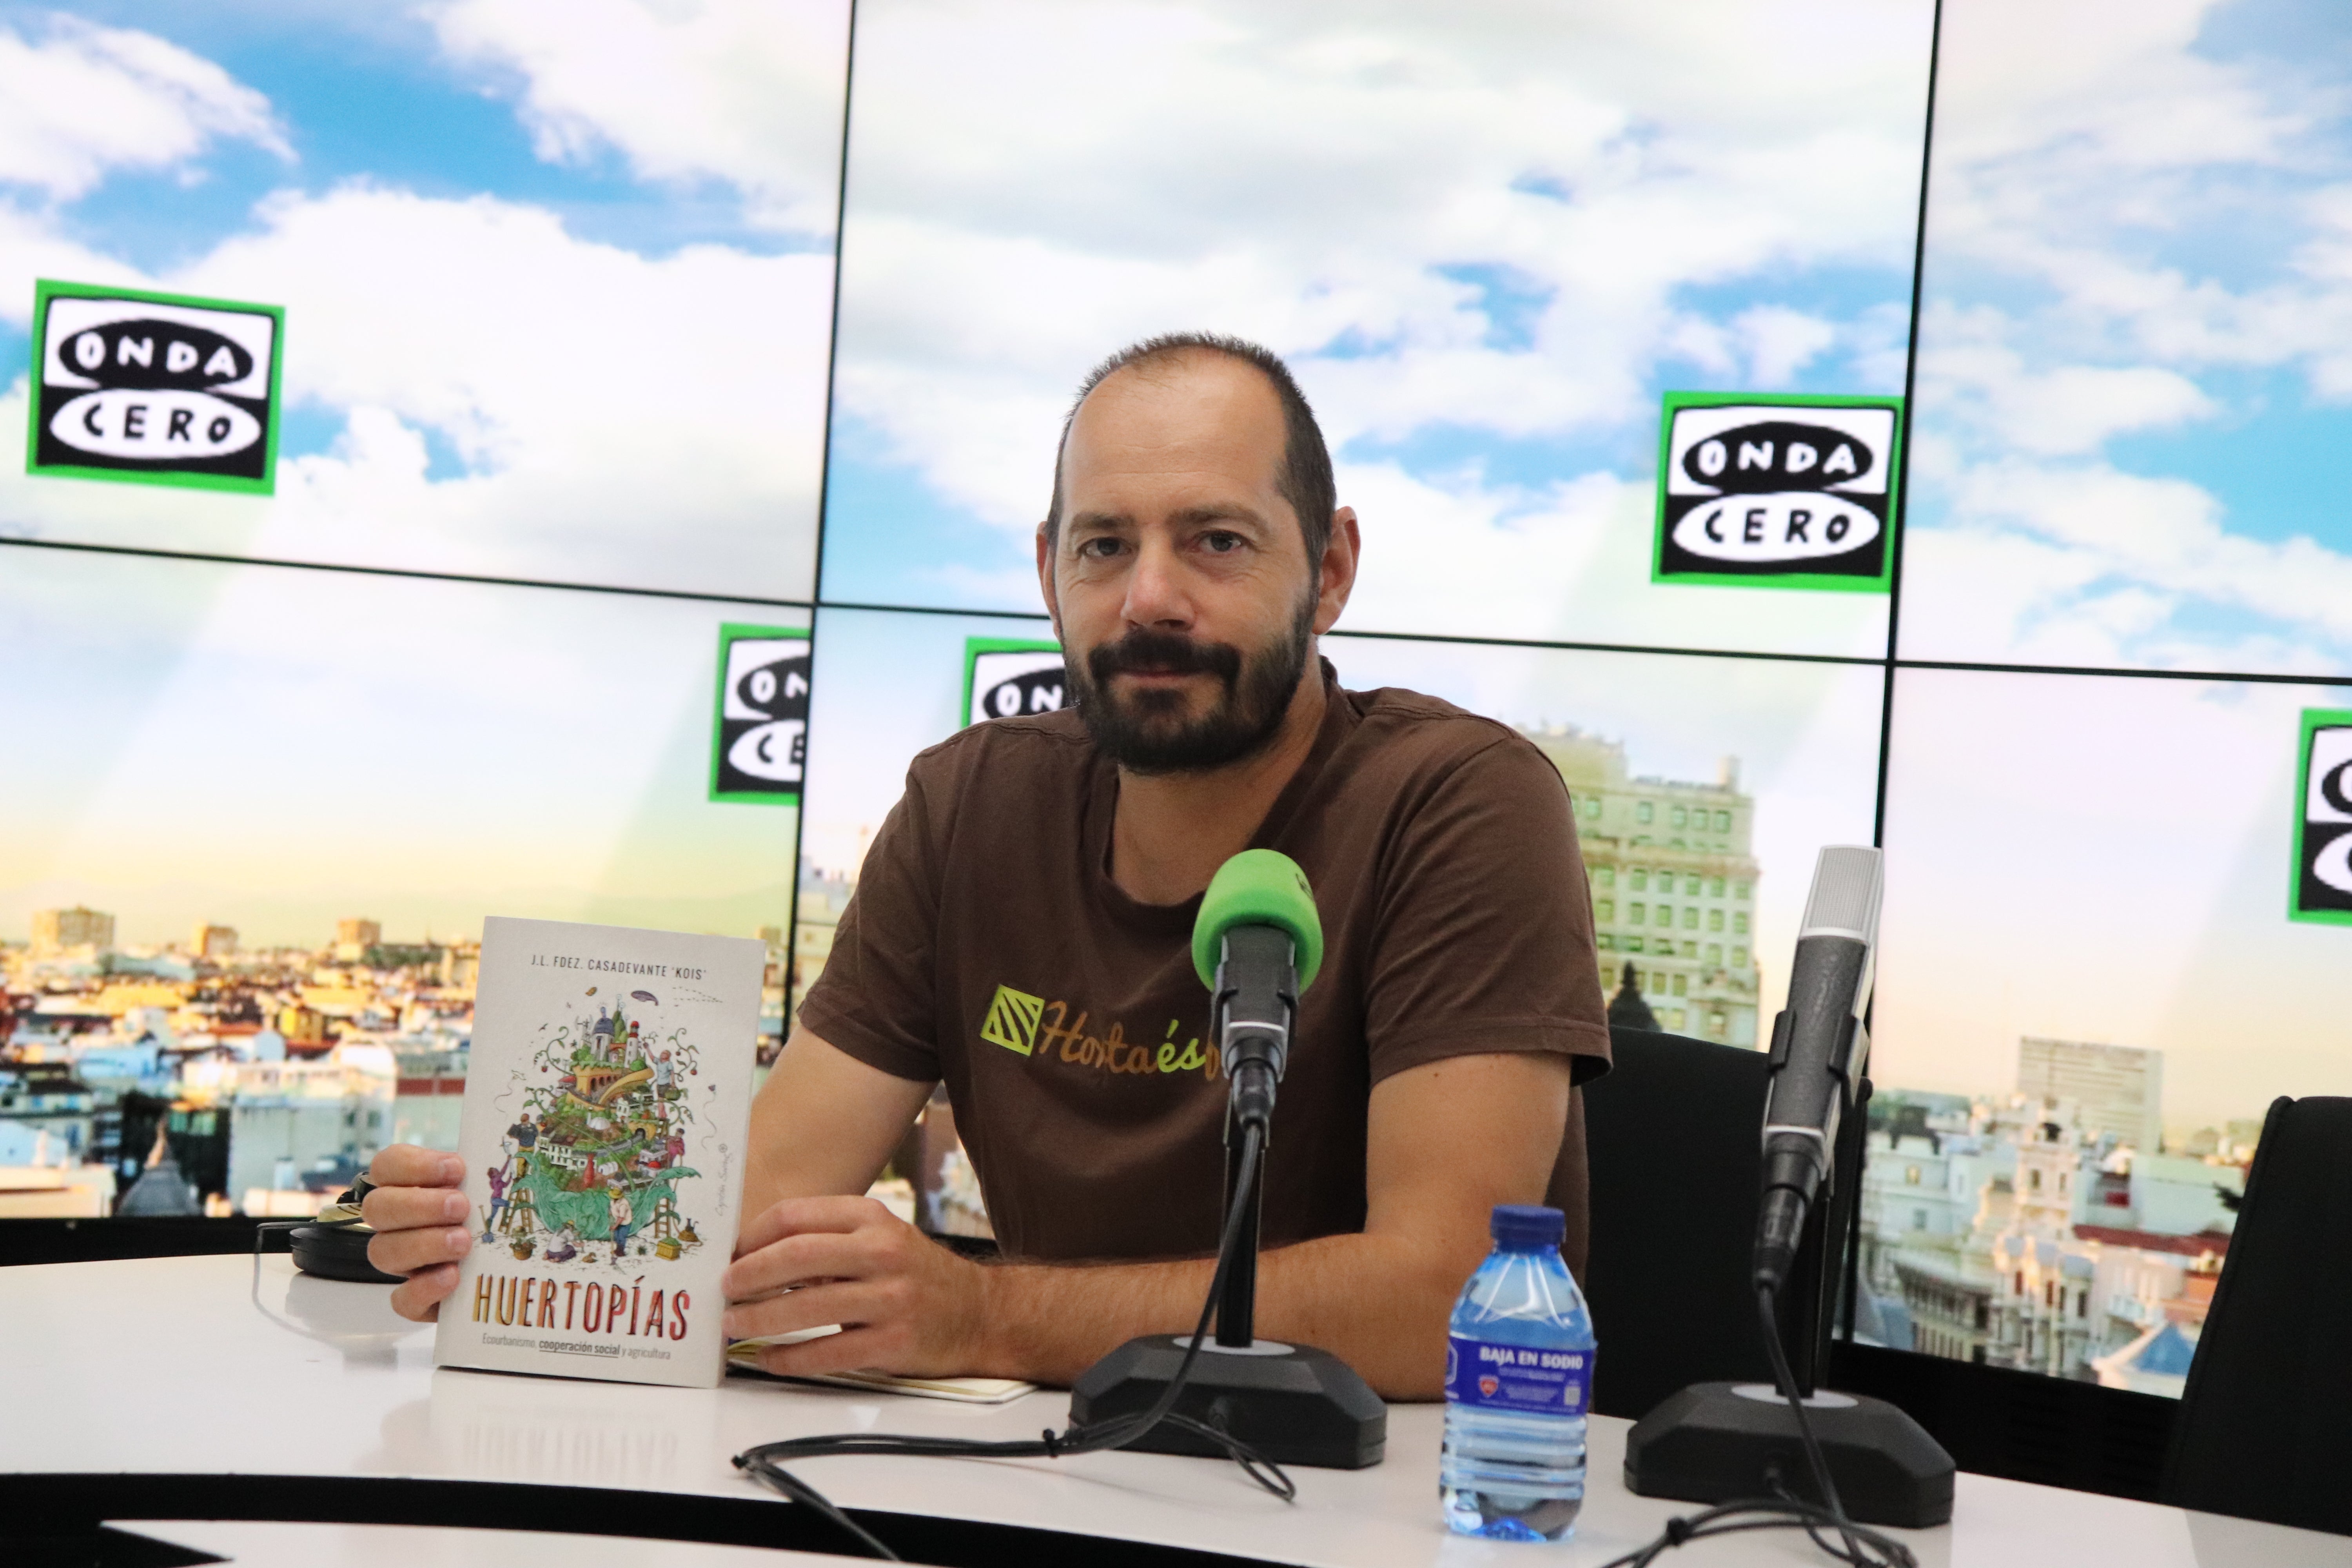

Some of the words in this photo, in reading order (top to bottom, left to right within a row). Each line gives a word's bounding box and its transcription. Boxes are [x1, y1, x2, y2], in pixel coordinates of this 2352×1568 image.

[75, 332, 237, 379] ONDA
[83, 400, 232, 444] CERO
[1698, 439, 1857, 476] ONDA
[1705, 508, 1849, 544] CERO
[531, 955, 548, 966] J.L.
[554, 956, 583, 970] FDEZ.
[588, 959, 666, 977] CASADEVANTE
[472, 1274, 690, 1341] HUERTOPÍAS
[539, 1339, 592, 1353] cooperación
[594, 1344, 620, 1355] social
[622, 1348, 626, 1357] y
[628, 1347, 671, 1359] agricultura
[1479, 1346, 1515, 1366] BAJA
[1517, 1350, 1538, 1366] EN
[1541, 1353, 1583, 1370] SODIO
